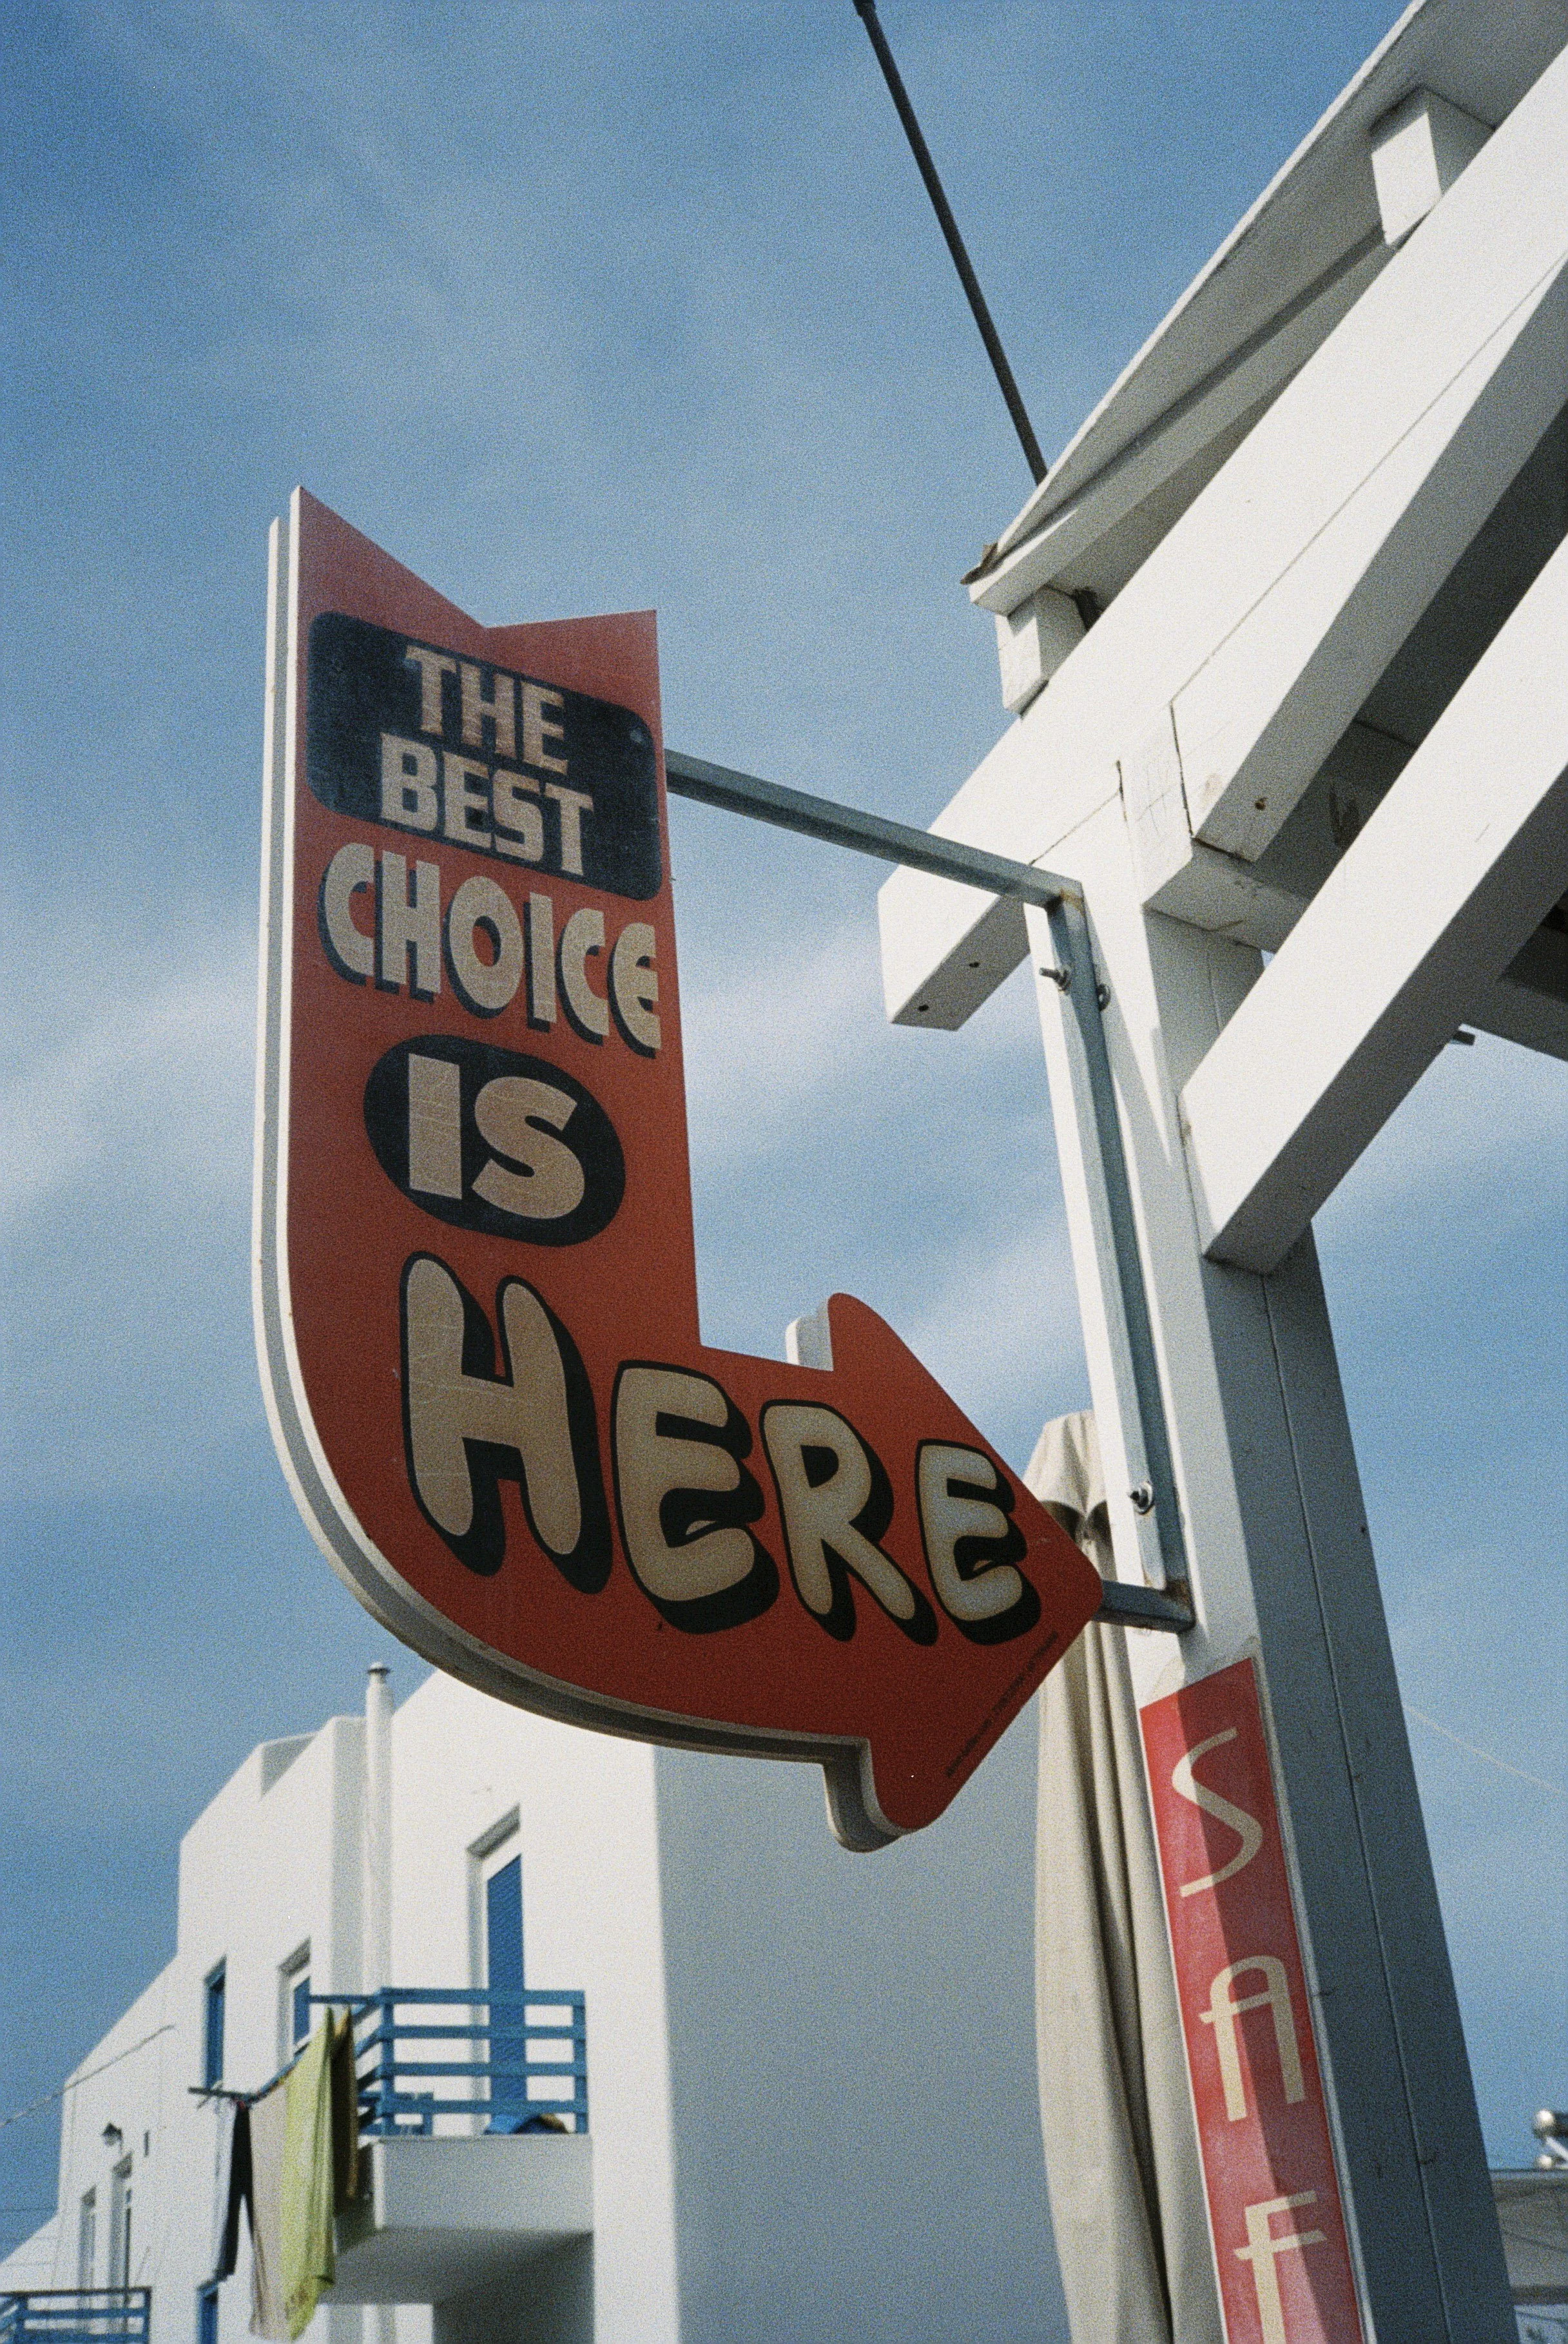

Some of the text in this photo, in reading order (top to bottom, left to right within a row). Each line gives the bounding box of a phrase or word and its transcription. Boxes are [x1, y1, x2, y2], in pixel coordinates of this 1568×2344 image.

[405, 645, 568, 775] THE
[380, 731, 594, 877] BEST
[319, 842, 662, 1057] CHOICE
[409, 1052, 586, 1219] IS
[401, 1252, 1039, 1643] HERE
